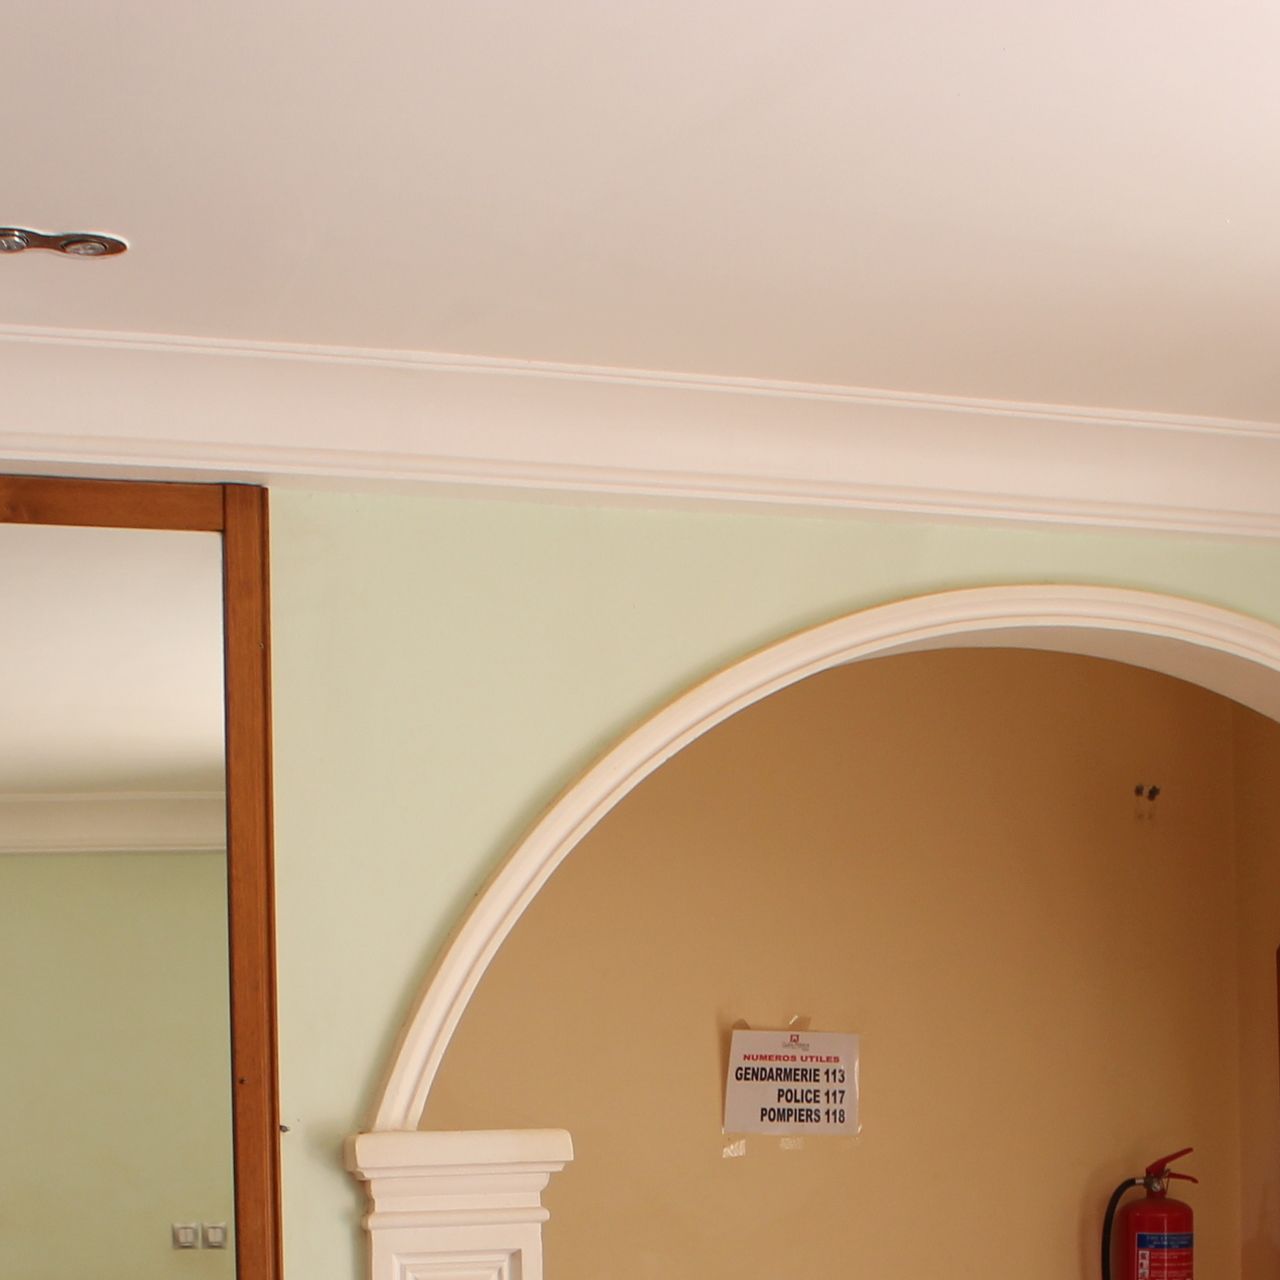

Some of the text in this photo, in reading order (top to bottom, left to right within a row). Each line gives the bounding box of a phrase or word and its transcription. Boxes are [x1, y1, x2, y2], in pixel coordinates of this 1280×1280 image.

[743, 1054, 840, 1063] NUMEROS UTILES
[735, 1066, 846, 1084] GENDARMERIE 113
[777, 1088, 846, 1105] POLICE 117
[760, 1107, 846, 1124] POMPIERS 118
